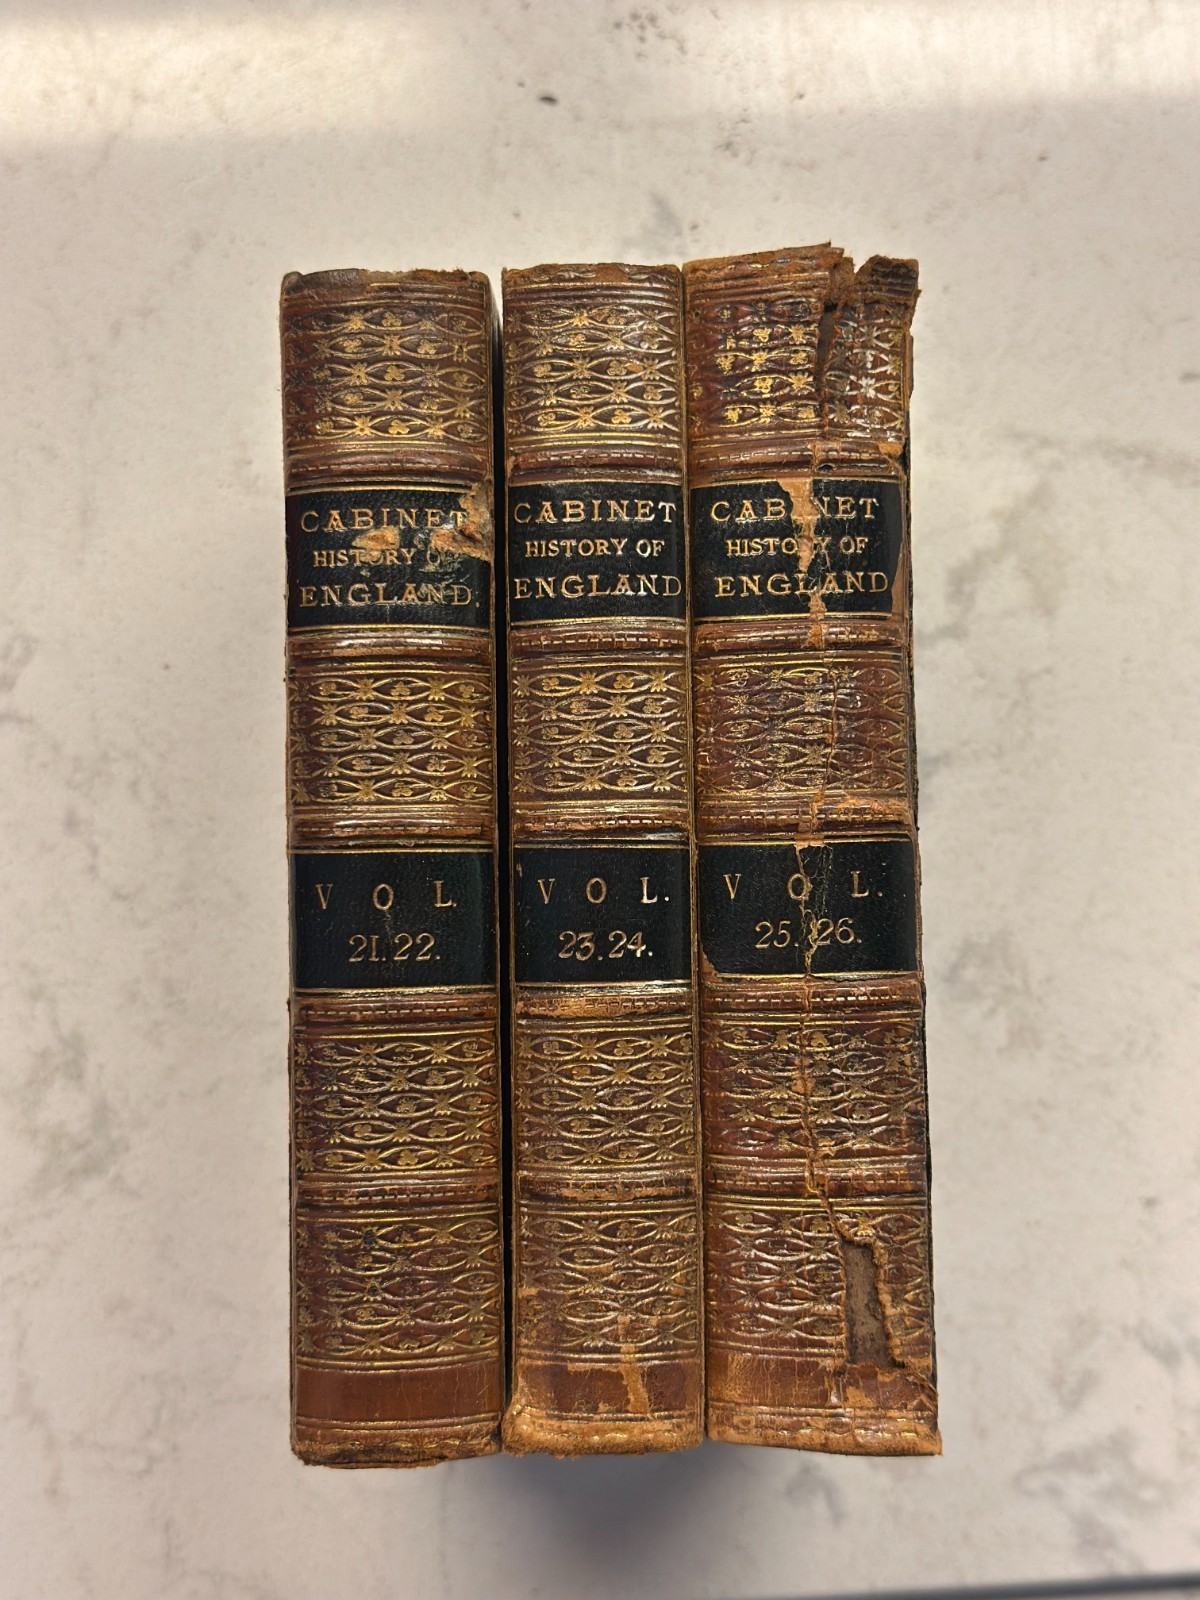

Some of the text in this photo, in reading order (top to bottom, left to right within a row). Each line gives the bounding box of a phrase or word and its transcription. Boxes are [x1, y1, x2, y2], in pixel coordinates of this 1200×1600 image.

[301, 508, 468, 532] CABINET
[514, 499, 677, 524] CABINET
[710, 496, 880, 522] CABNET
[525, 537, 665, 558] HISTORY OF
[726, 535, 869, 557] HISTOY OF
[514, 573, 682, 599] ENGLAND
[714, 571, 889, 598] ENGLAND
[558, 930, 653, 961] 23.24.
